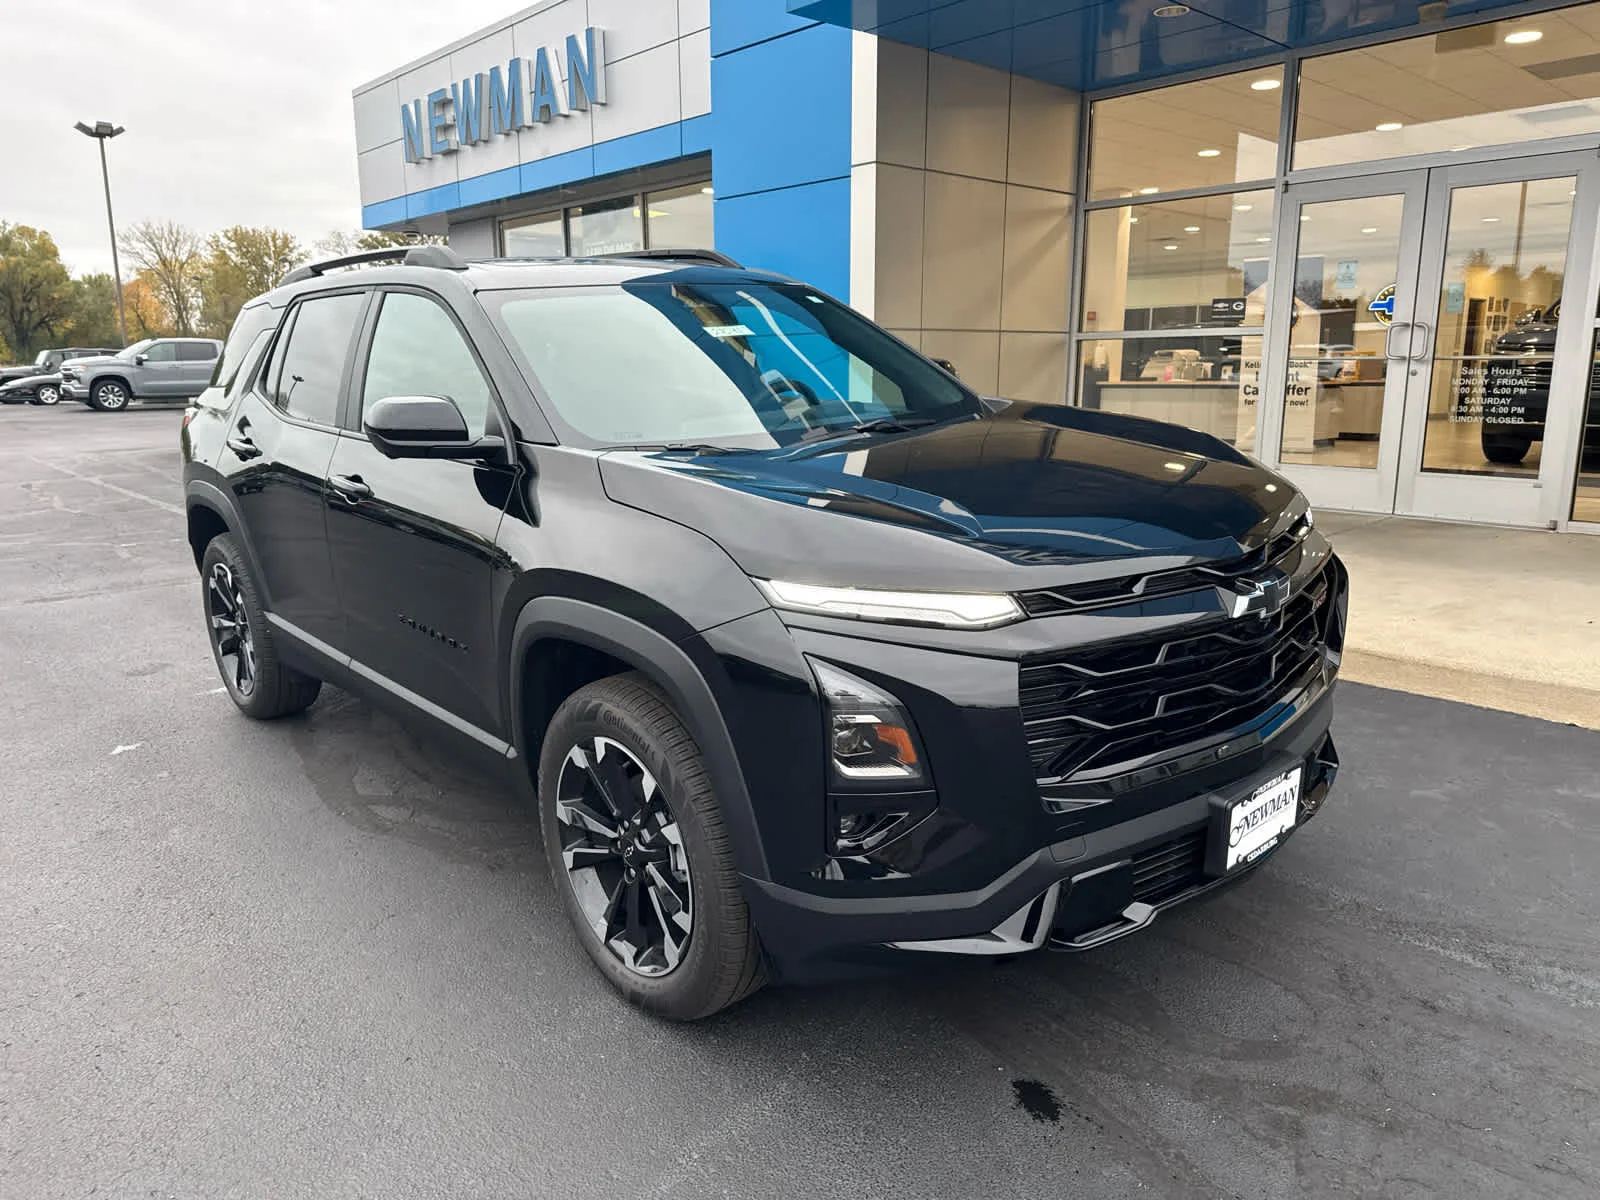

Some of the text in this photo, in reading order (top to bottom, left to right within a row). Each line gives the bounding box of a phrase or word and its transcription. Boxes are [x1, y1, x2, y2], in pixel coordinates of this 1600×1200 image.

[401, 27, 605, 163] NEWMAN
[1462, 367, 1522, 375] Sales Hours
[1451, 378, 1490, 386] MONDAY
[1496, 378, 1530, 386] FRIDAY
[1243, 384, 1311, 395] Ca ffer
[1513, 387, 1528, 395] PM
[1464, 397, 1512, 405] SATURDAY
[1490, 406, 1509, 414] 4:00
[1511, 406, 1525, 414] PM
[1449, 415, 1525, 424] SUNDAY CLOSED
[1229, 784, 1298, 848] NEWMAN
